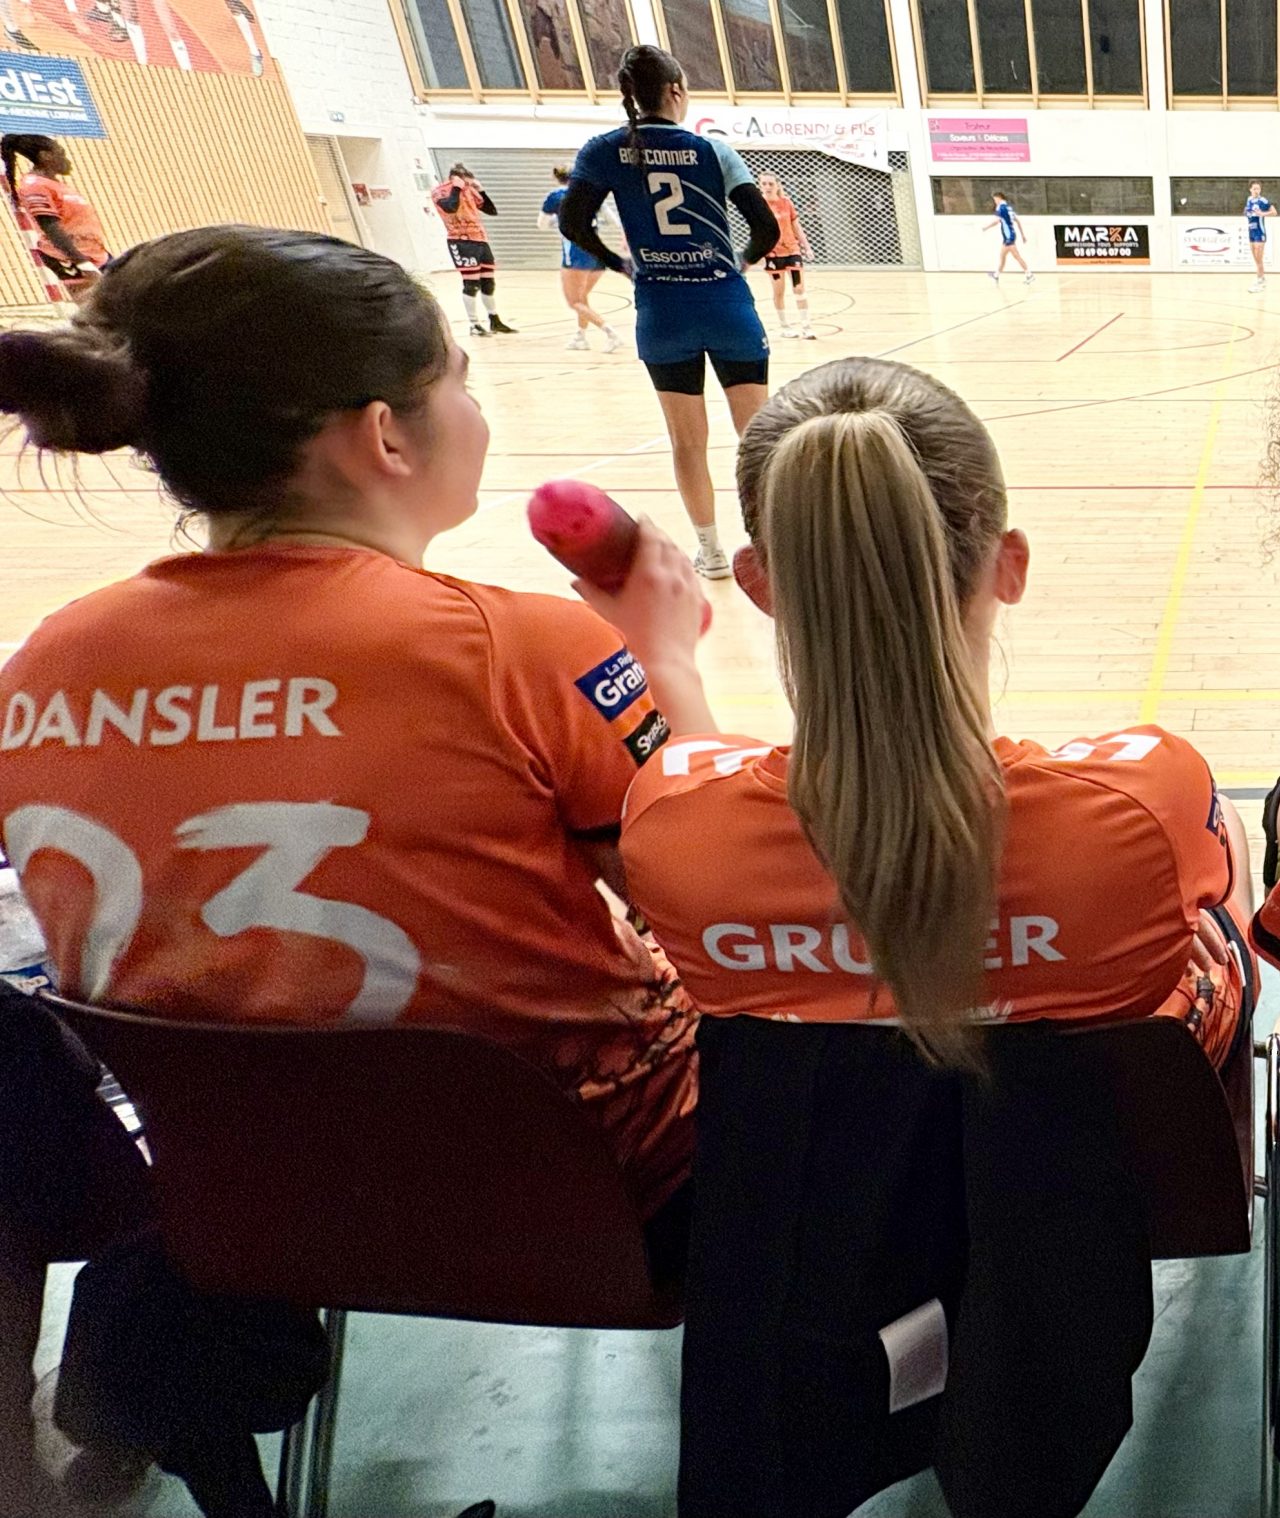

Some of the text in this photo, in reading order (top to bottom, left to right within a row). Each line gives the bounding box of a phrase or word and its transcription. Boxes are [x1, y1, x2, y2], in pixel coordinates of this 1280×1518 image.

[647, 171, 693, 236] 2
[1064, 226, 1139, 242] MARKA
[461, 257, 478, 267] 28
[640, 247, 713, 263] Essonne
[0, 675, 343, 752] DANSLER
[703, 914, 1068, 975] GRUER
